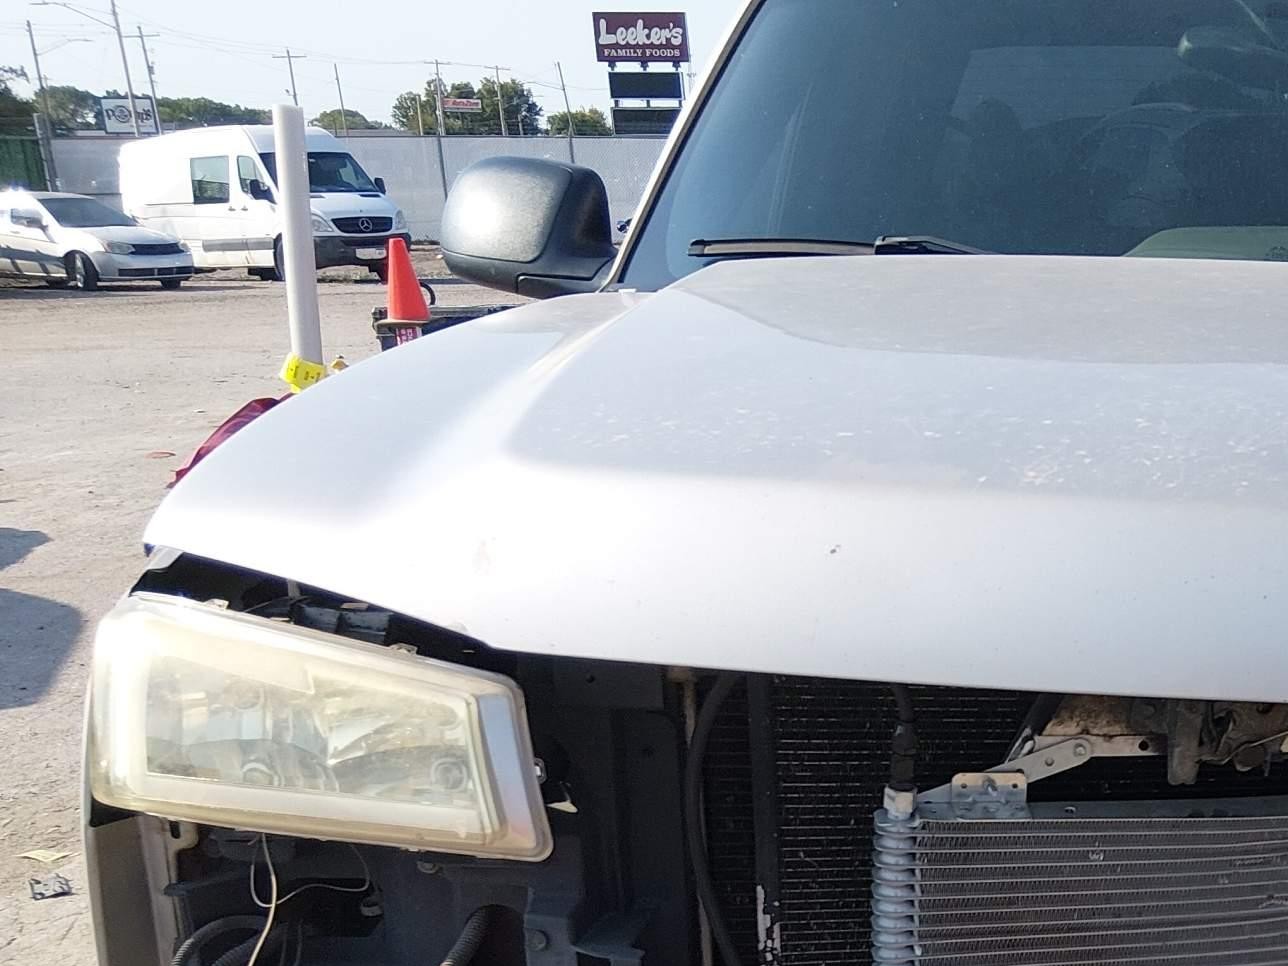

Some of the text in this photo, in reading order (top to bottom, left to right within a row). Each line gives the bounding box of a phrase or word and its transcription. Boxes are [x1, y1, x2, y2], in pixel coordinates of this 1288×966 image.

[599, 18, 683, 45] Leeker's
[604, 48, 680, 57] FAMILY FOODS
